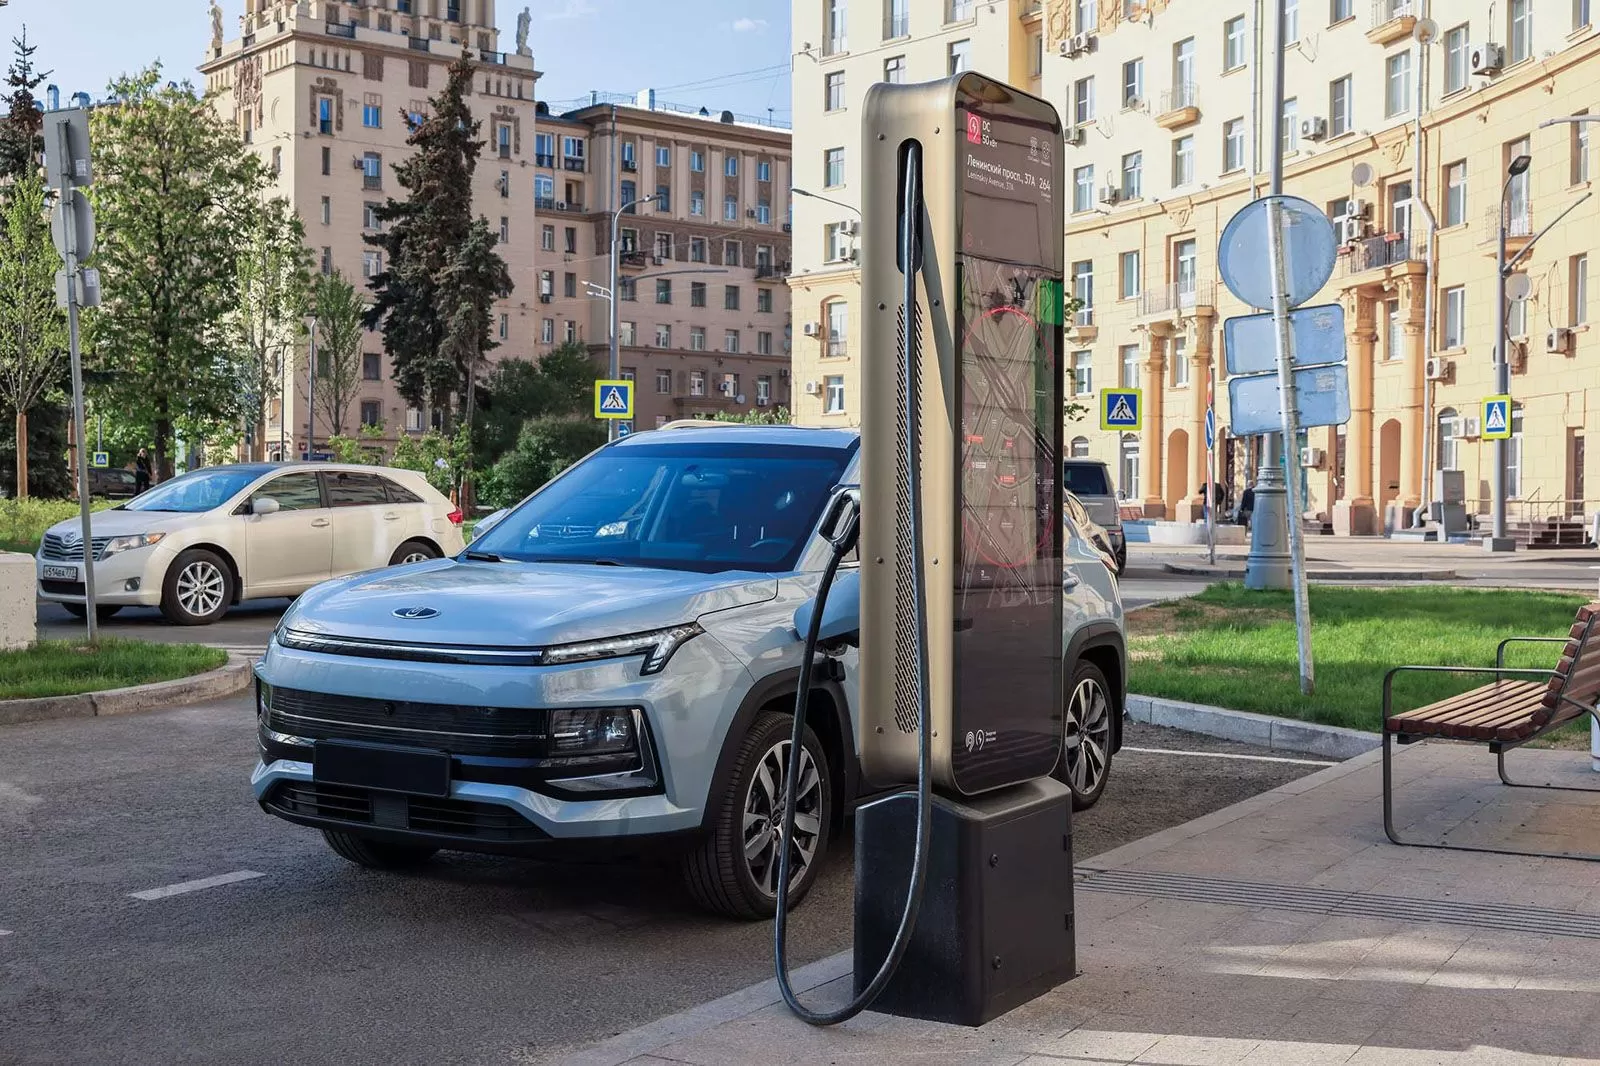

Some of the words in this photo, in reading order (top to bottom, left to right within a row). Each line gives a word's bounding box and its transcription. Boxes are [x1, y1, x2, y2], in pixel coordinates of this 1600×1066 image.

[982, 121, 990, 132] DC
[982, 134, 990, 146] 50
[967, 154, 1002, 176] Ленинский
[1039, 177, 1051, 191] 264
